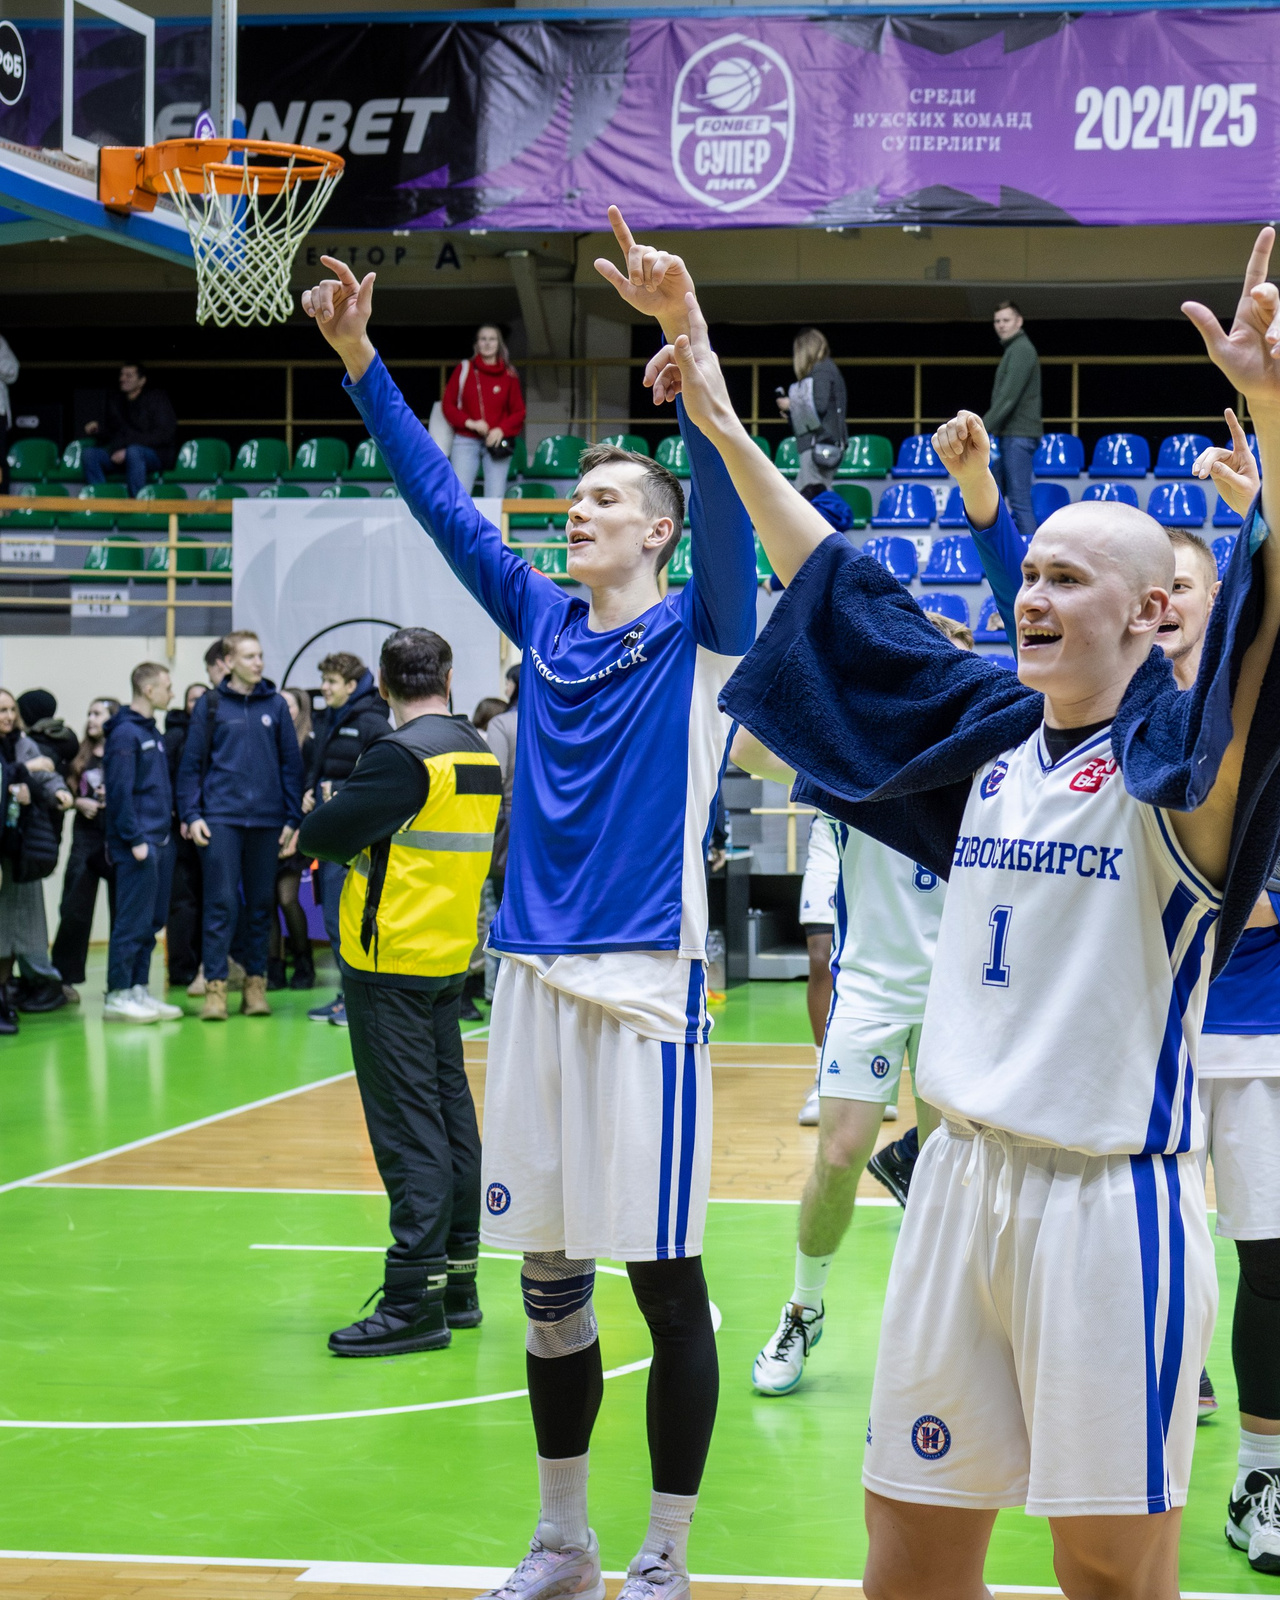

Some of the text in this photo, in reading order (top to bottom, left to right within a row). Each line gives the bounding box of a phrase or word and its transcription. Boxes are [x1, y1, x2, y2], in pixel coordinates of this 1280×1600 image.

[909, 88, 977, 107] СРЕДИ
[155, 97, 450, 156] FNBET
[701, 119, 764, 132] FONBET
[852, 111, 1034, 131] МУЖСКИХ КОМАНД
[1074, 83, 1257, 151] 2024/25
[881, 135, 1002, 152] СУПЕРЛИГИ
[694, 138, 771, 176] СУПЕР
[705, 177, 757, 191] ЛИГА
[435, 242, 461, 270] А
[981, 904, 1013, 988] 1
